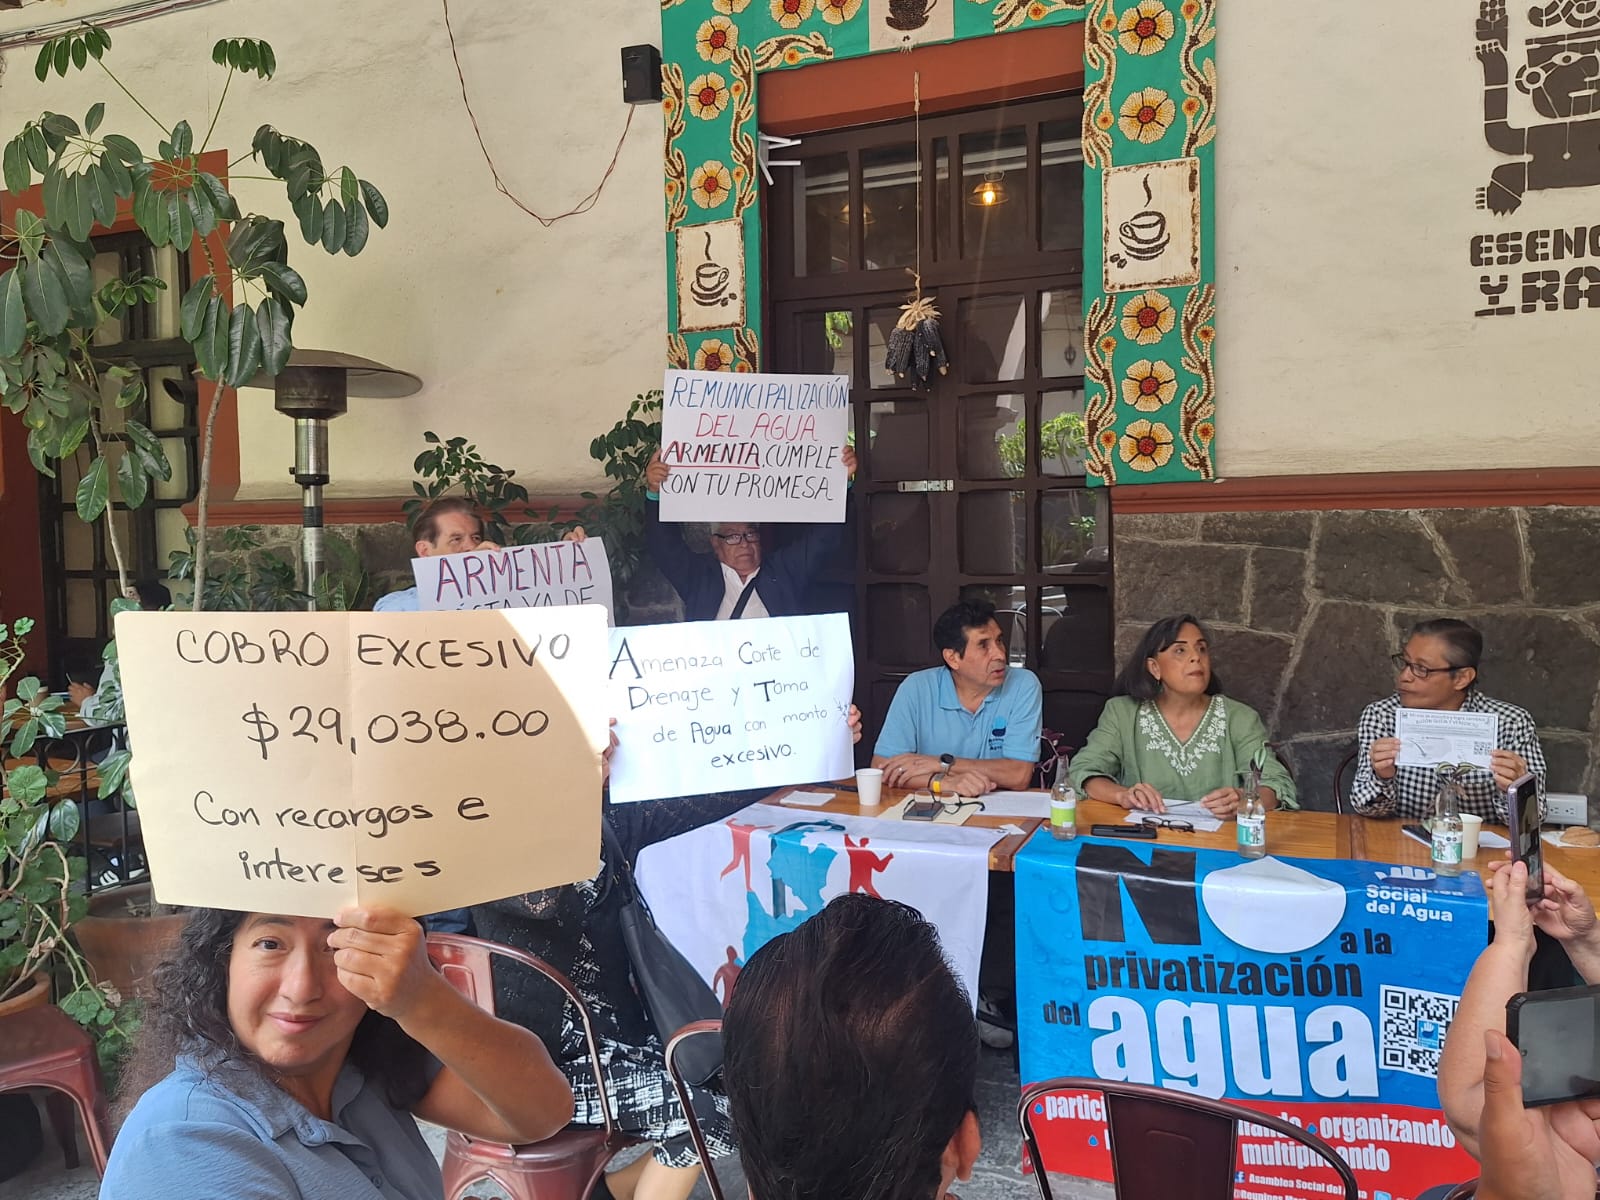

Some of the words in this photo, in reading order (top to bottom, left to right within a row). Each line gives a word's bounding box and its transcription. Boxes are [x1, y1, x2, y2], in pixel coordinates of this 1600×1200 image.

[1475, 275, 1515, 317] Y
[669, 377, 849, 410] REMUNICIPALIZACIÓN
[696, 413, 739, 438] DEL
[751, 413, 818, 441] AGUA
[661, 472, 700, 494] CON
[704, 474, 730, 496] TU
[735, 472, 833, 500] PROMESA
[436, 542, 593, 602] ARMENTA
[176, 629, 329, 667] COBRO
[358, 633, 571, 668] EXCESIVO
[608, 637, 723, 679] Amenaza
[738, 641, 782, 664] Corte
[800, 638, 821, 658] de
[628, 686, 714, 710] Drenaje
[731, 687, 740, 706] y
[754, 679, 809, 701] Toma
[242, 703, 549, 760] $29,038.00
[653, 725, 678, 743] de
[690, 722, 732, 744] Agua
[744, 720, 767, 732] con
[783, 705, 828, 724] monto
[193, 790, 260, 827] Con
[277, 803, 433, 838] recargos
[458, 796, 489, 821] e
[239, 848, 442, 883] intereses
[1366, 885, 1427, 904] Social
[1366, 900, 1395, 915] del
[1402, 903, 1453, 922] Agua
[1340, 933, 1357, 955] a
[1364, 928, 1393, 954] la
[1084, 951, 1363, 998] privatización
[1043, 1000, 1081, 1026] del
[1087, 995, 1380, 1100] agua
[1319, 1114, 1456, 1149] organizando
[1242, 1140, 1390, 1171] multipliando
